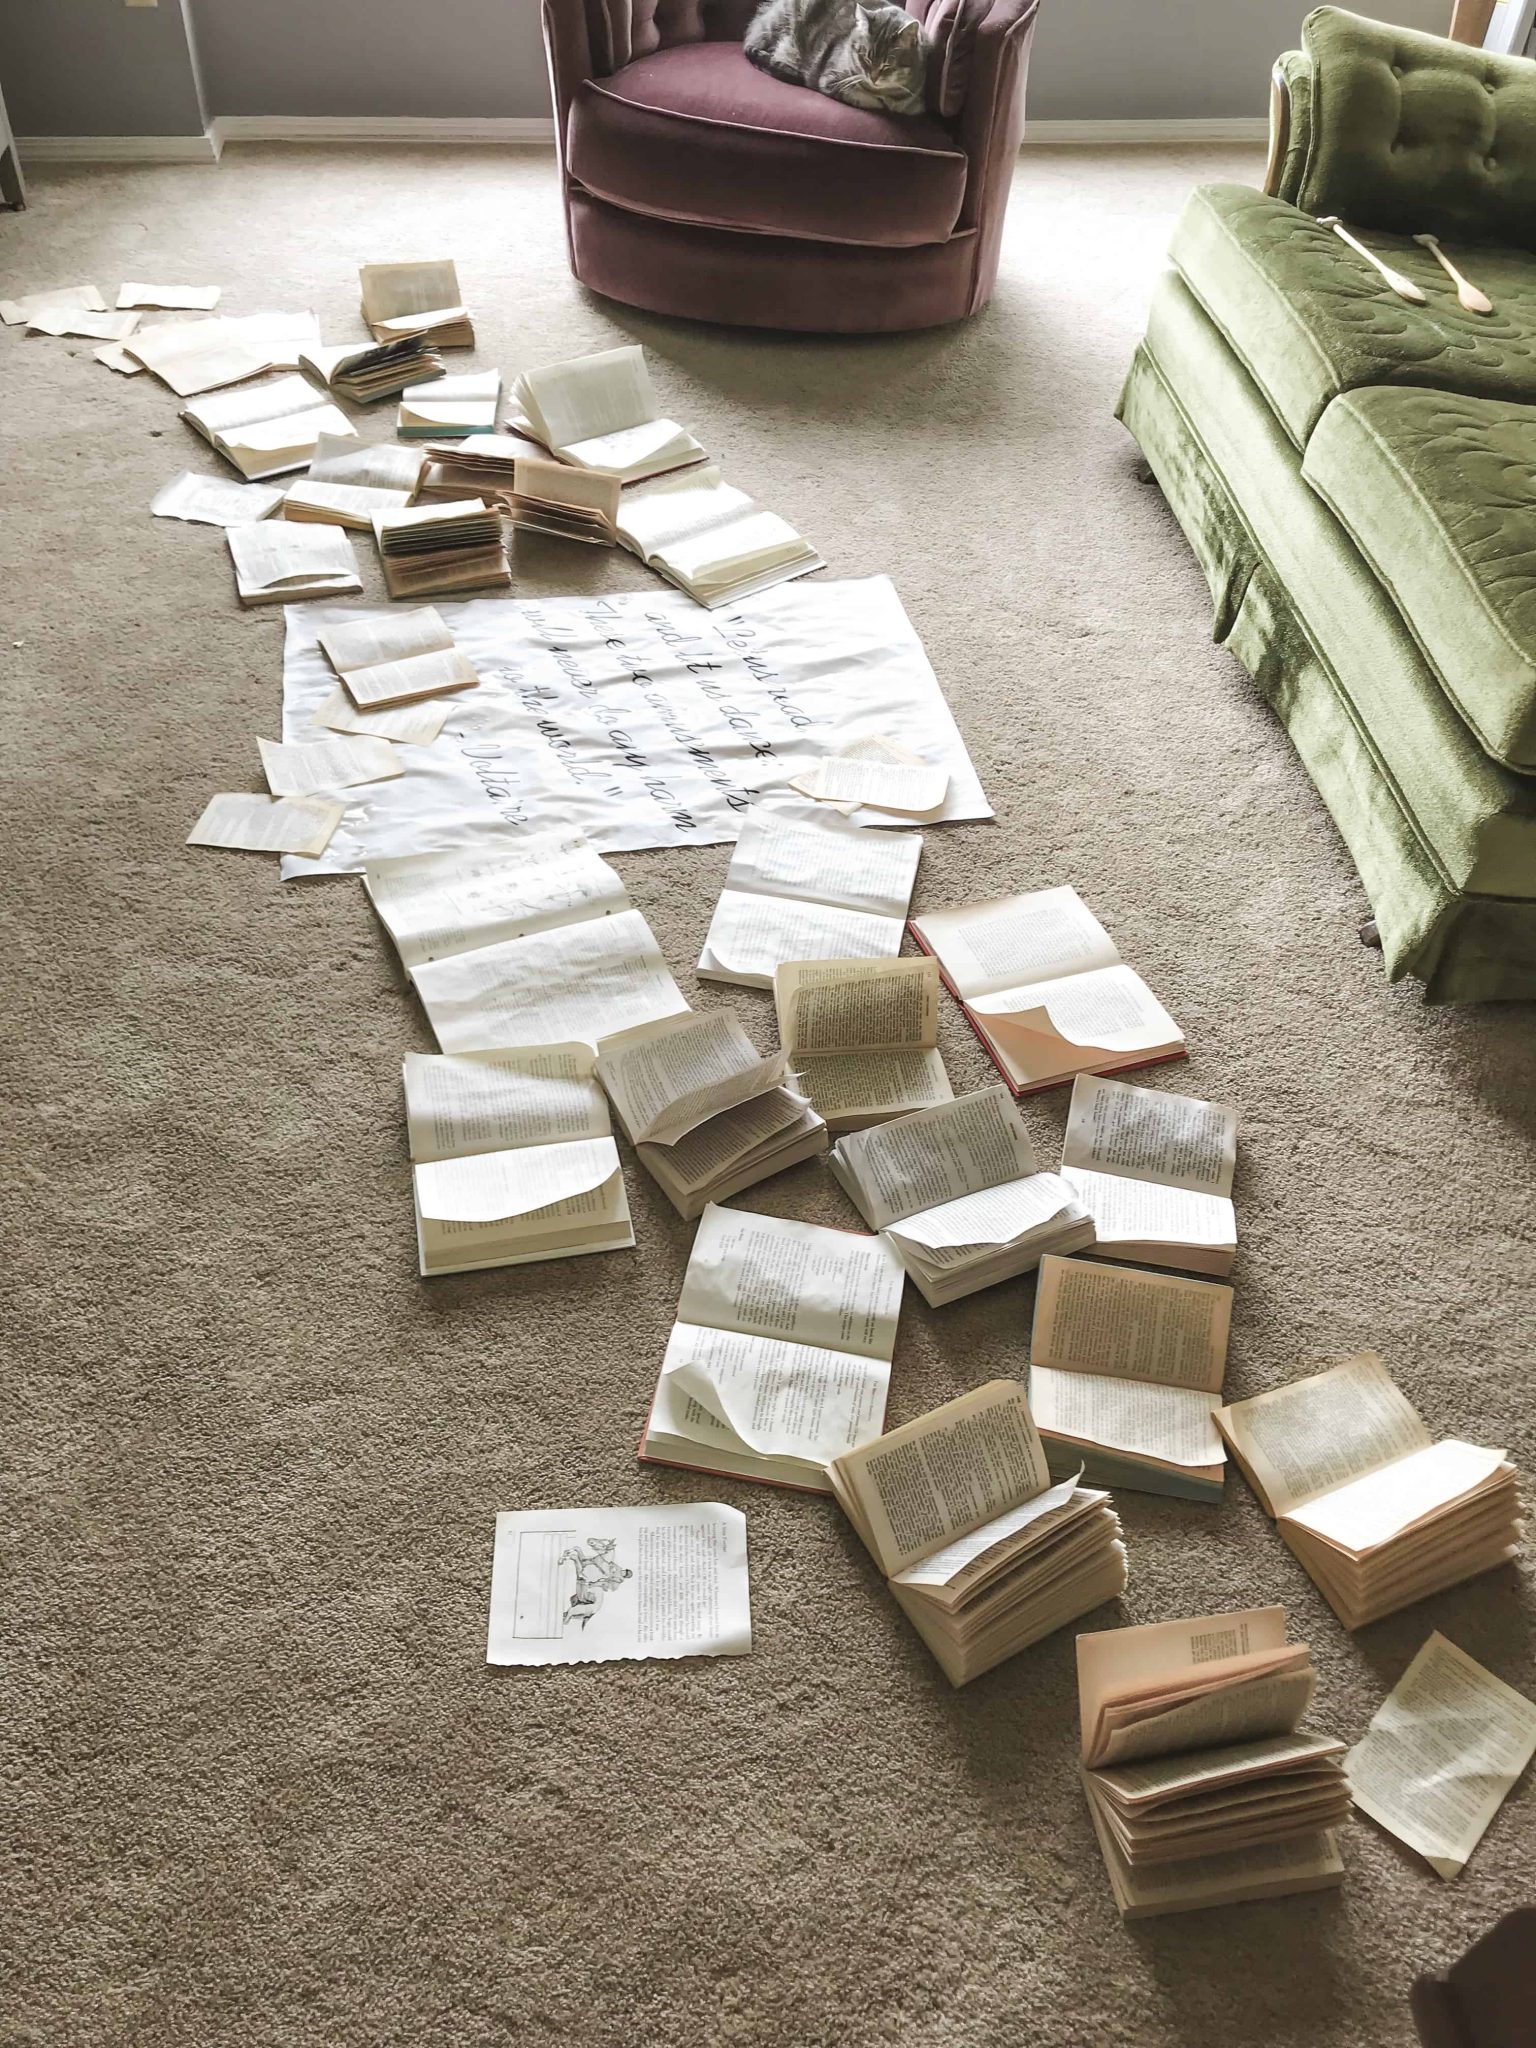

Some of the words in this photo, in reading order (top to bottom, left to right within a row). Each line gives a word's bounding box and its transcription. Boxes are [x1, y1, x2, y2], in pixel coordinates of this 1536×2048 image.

[644, 612, 702, 648] and
[547, 645, 599, 700] never
[674, 651, 723, 674] lt
[516, 685, 560, 715] the
[696, 679, 732, 703] us
[588, 703, 632, 727] do
[608, 729, 650, 772] any
[639, 774, 698, 833] harm
